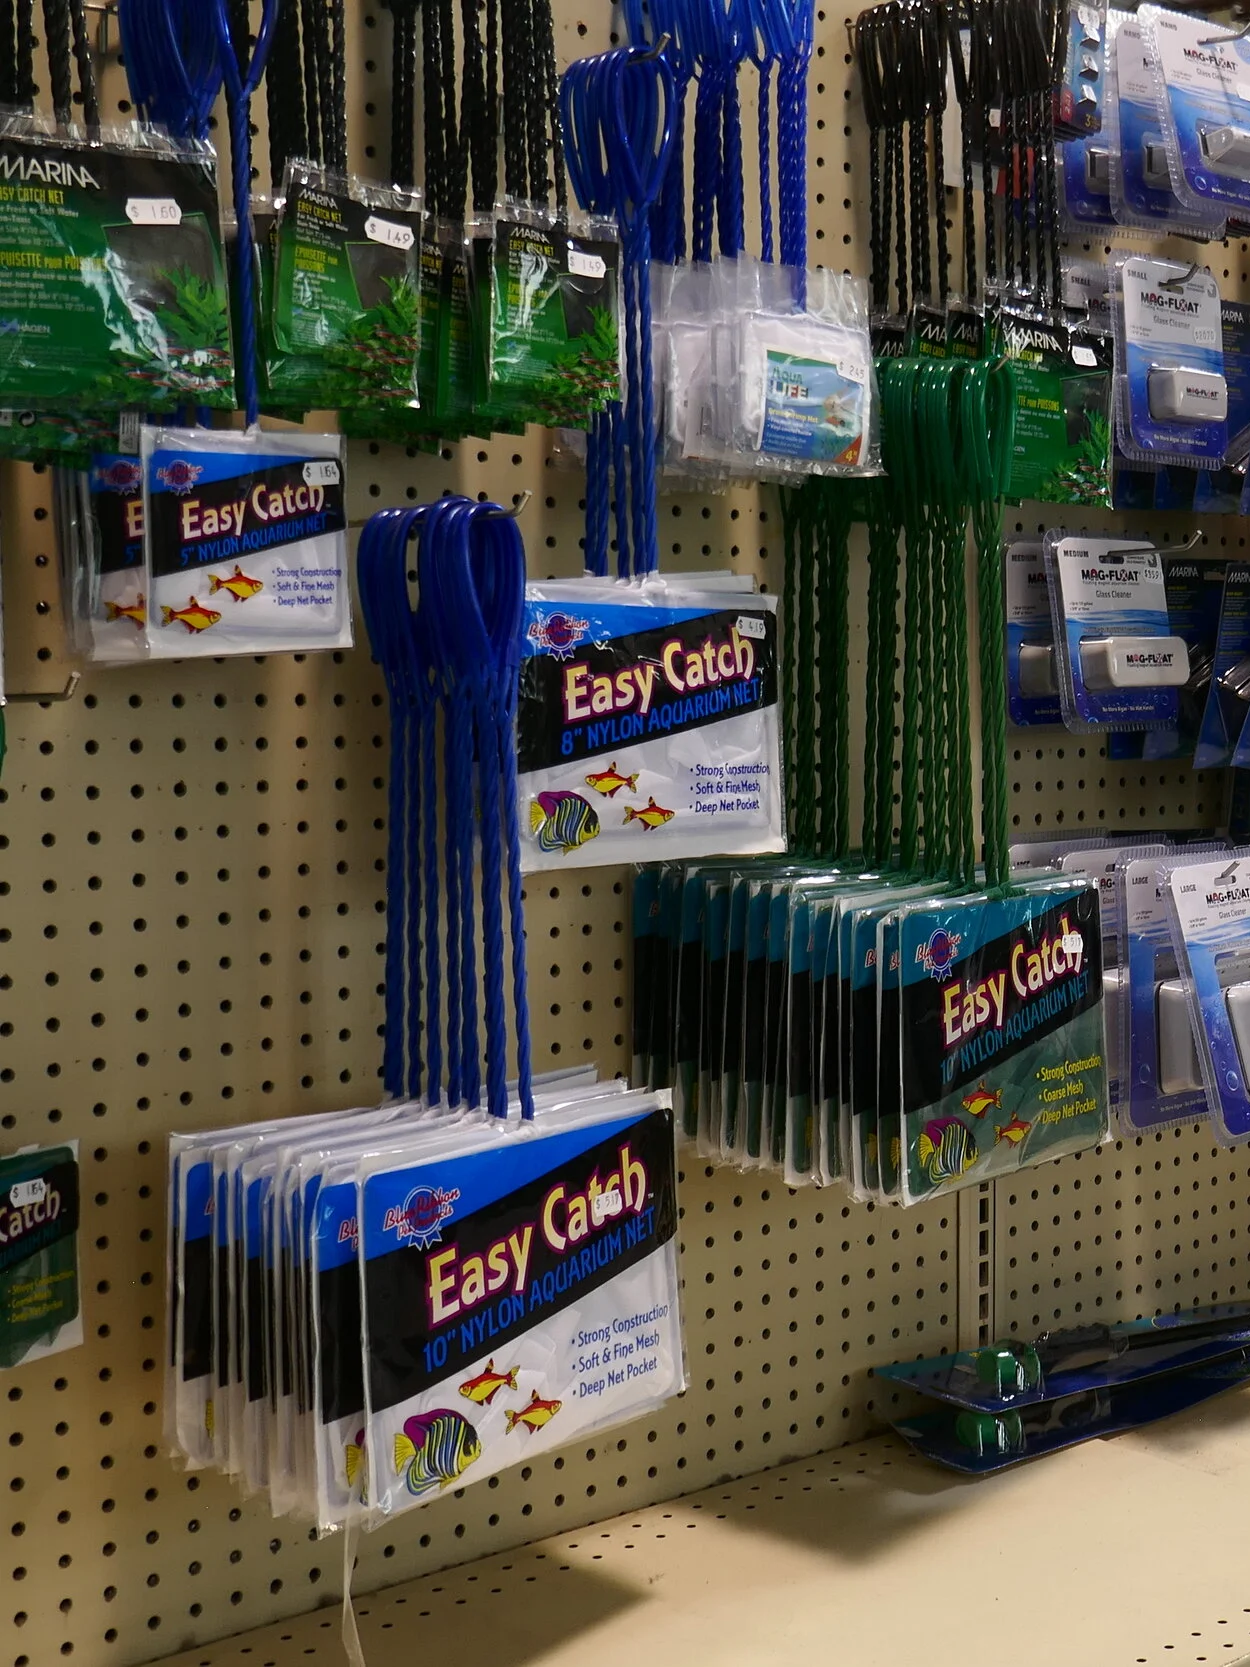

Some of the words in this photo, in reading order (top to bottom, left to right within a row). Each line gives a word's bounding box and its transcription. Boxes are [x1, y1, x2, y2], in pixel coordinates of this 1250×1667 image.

[0, 155, 100, 190] MARINA
[17, 187, 47, 203] CATCH
[48, 191, 64, 205] NET
[299, 188, 338, 210] MARINA
[131, 206, 139, 218] $
[297, 201, 314, 215] EASY
[331, 212, 342, 222] NET
[370, 223, 376, 234] $
[510, 227, 550, 244] MARINA
[510, 240, 525, 251] EASY
[542, 246, 554, 257] NET
[0, 252, 41, 269] PUISETTE
[1128, 269, 1148, 280] SMALL
[1153, 315, 1168, 326] Glass
[1008, 327, 1062, 352] MARINA
[772, 367, 803, 385] AQUA
[305, 466, 312, 479] $
[182, 500, 247, 540] Easy
[252, 485, 324, 521] Catch
[180, 547, 195, 567] 5"
[198, 536, 241, 563] NYLON
[242, 521, 304, 554] AQUARIUM
[305, 513, 328, 535] NET
[1064, 550, 1089, 558] MEDIUM
[276, 566, 300, 580] Strong
[1168, 566, 1199, 577] MARINA
[296, 596, 309, 606] Net
[310, 596, 333, 606] Pocket
[1096, 590, 1111, 598] Glass
[1112, 590, 1132, 598] Cleaner
[738, 619, 744, 631] $
[565, 664, 653, 720] Easy
[663, 627, 754, 691] Catch
[561, 728, 583, 756] 8"
[587, 715, 644, 744] NYLON
[648, 691, 732, 731] AQUARIUM
[733, 678, 760, 704] NET
[695, 763, 724, 779] Strong
[725, 763, 770, 776] Construction
[695, 782, 714, 794] Soft
[716, 782, 724, 794] &
[725, 782, 741, 794] Fine
[741, 781, 761, 793] Mesh
[695, 801, 718, 815] Deep
[719, 800, 735, 812] Net
[736, 799, 760, 811] Pocket
[1180, 884, 1196, 893] LARGE
[943, 973, 1006, 1046] Easy
[1011, 916, 1083, 997] Catch
[961, 1028, 1003, 1072] NYLON
[1005, 988, 1066, 1045] AQUARIUM
[1069, 970, 1090, 1004] NET
[1040, 1066, 1064, 1083] Strong
[1065, 1055, 1102, 1076] Construction
[1043, 1088, 1067, 1103] Coarse
[1066, 1081, 1084, 1098] Mesh
[1041, 1108, 1061, 1125] Deep
[1062, 1104, 1075, 1119] Net
[1076, 1097, 1097, 1117] Pocket
[12, 1188, 19, 1199] $
[416, 1185, 460, 1213] Ribbon
[428, 1222, 533, 1326] Easy
[543, 1143, 647, 1253] Catch
[423, 1327, 456, 1374] 10"
[461, 1294, 525, 1353] NYLON
[528, 1237, 622, 1312] AQUARIUM
[626, 1205, 655, 1254] NET
[577, 1326, 610, 1349] Strong
[613, 1303, 668, 1334] Construction
[578, 1354, 599, 1371] Soft
[602, 1348, 612, 1364] &
[614, 1343, 634, 1364] Fine
[636, 1331, 660, 1353] Mesh
[579, 1378, 606, 1399] Deep
[607, 1371, 626, 1388] Net
[627, 1357, 657, 1383] Pocket
